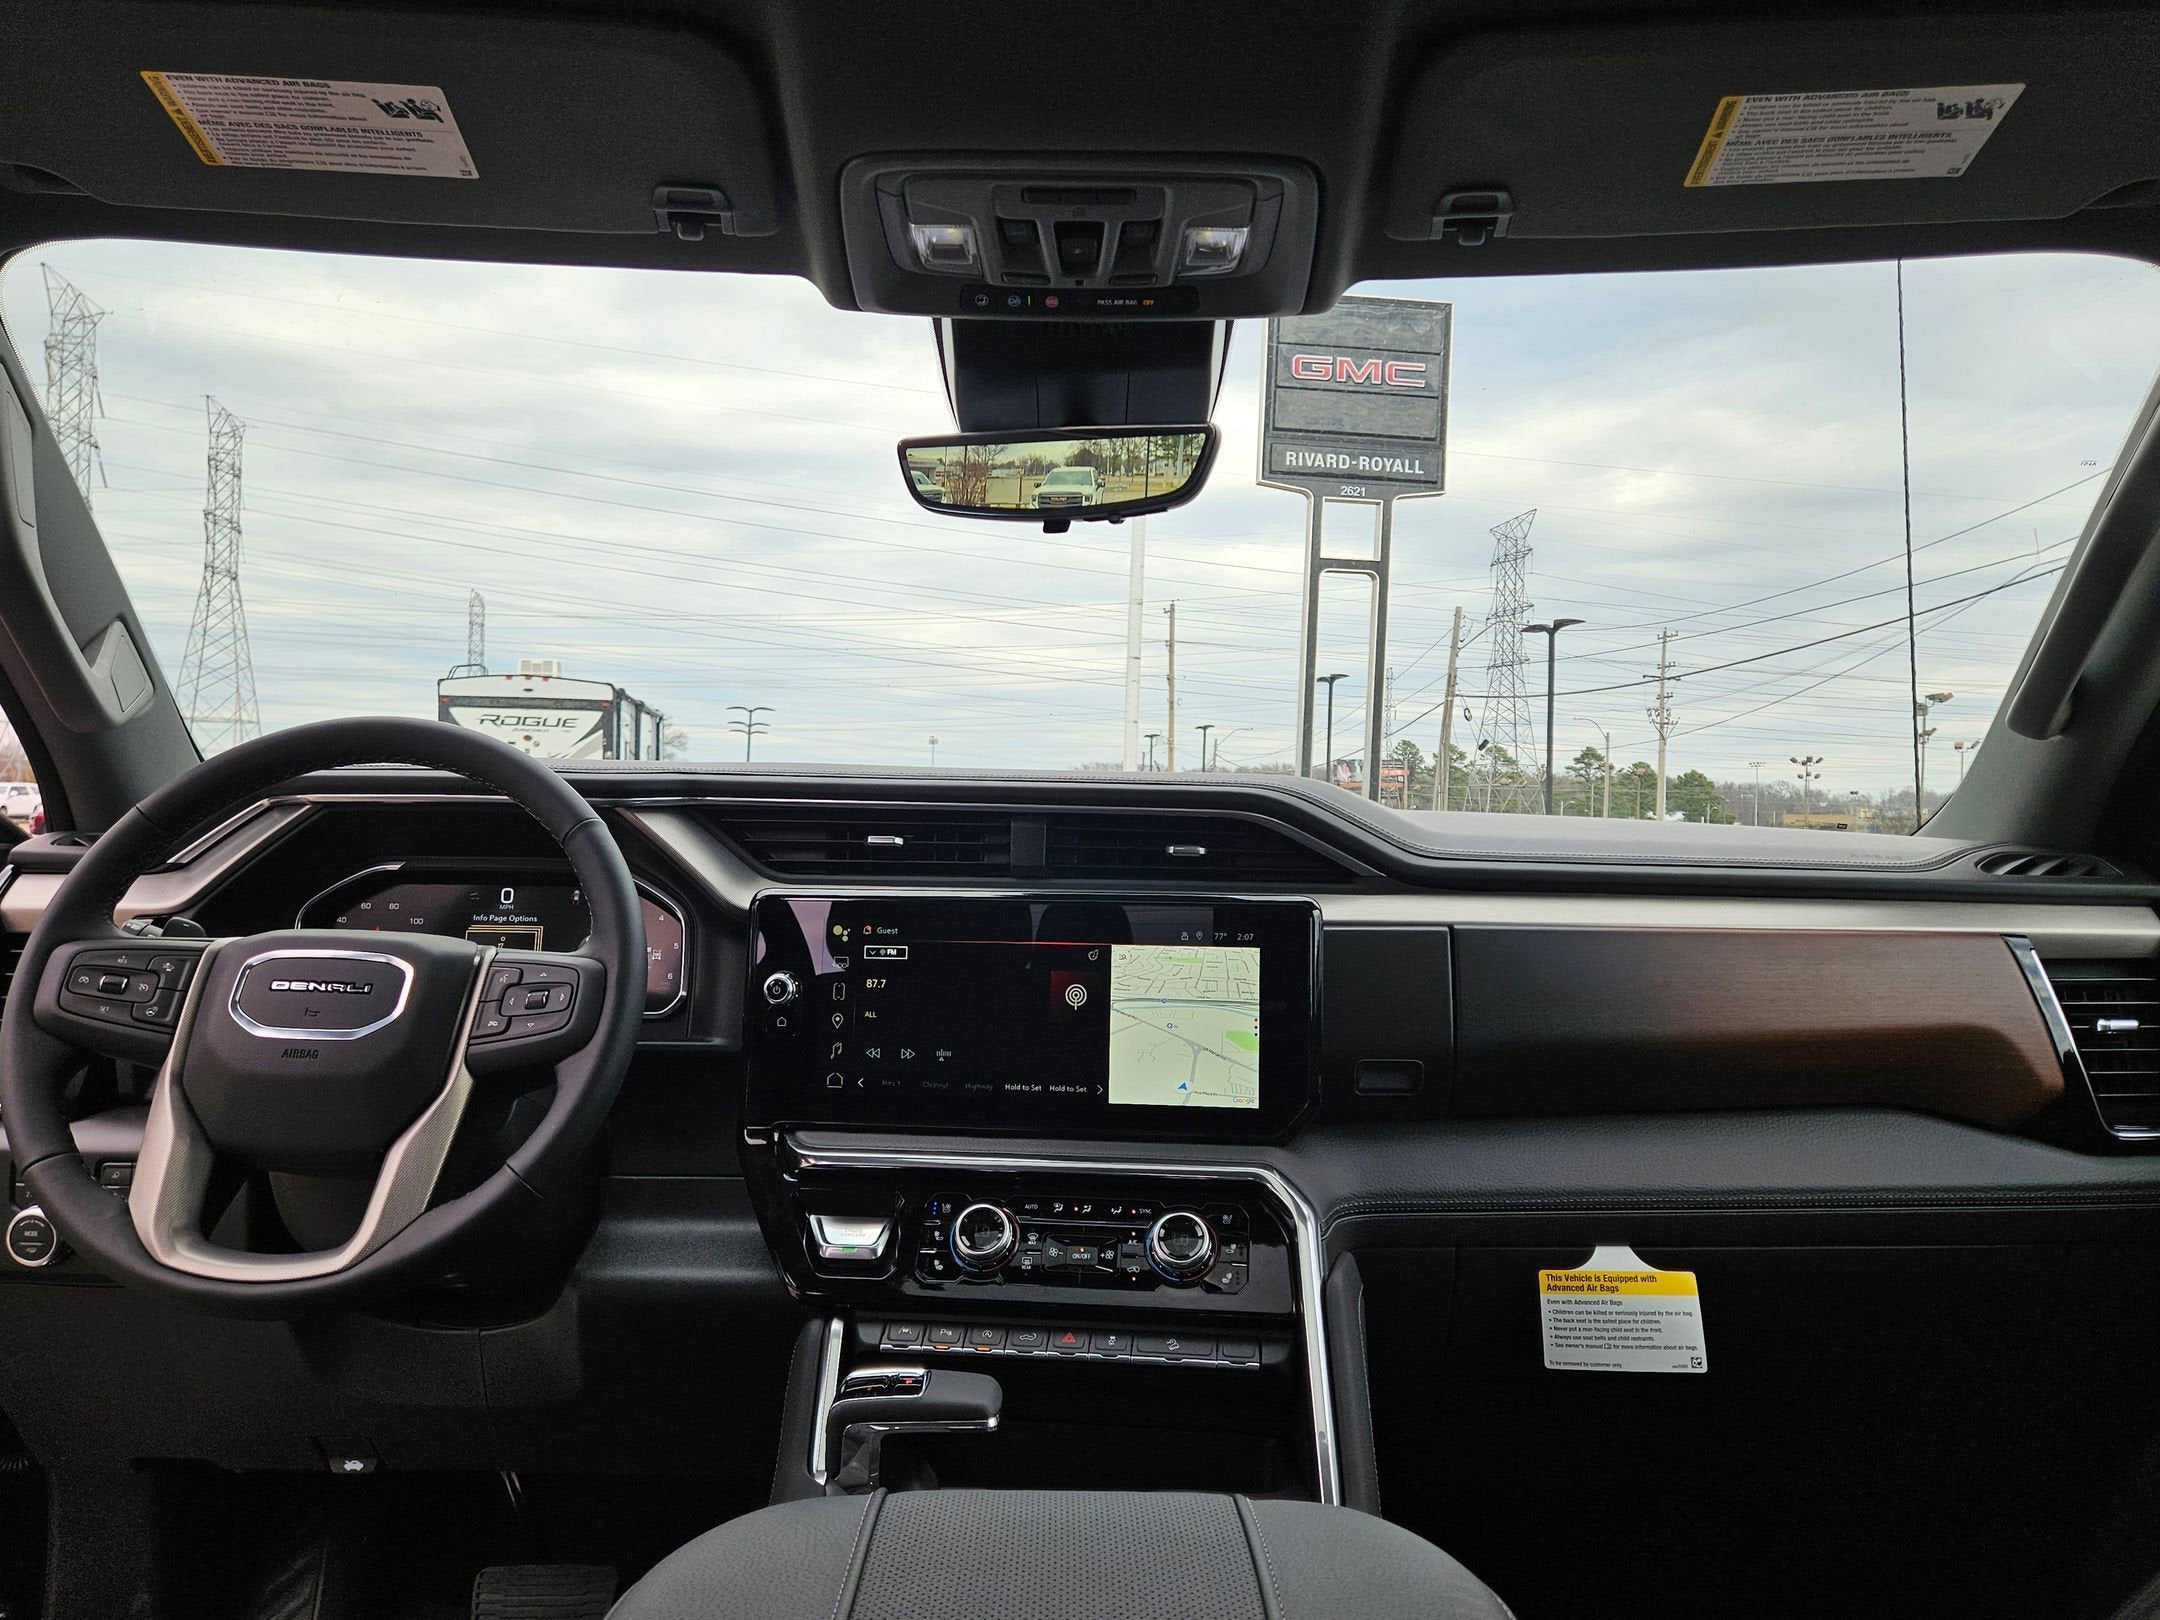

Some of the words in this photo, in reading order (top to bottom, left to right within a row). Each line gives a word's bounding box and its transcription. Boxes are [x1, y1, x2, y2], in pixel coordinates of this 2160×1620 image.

[225, 77, 280, 86] ADVANCED
[303, 81, 331, 89] BAGS
[1802, 93, 1859, 101] ADVANCED
[1291, 354, 1426, 388] GMC
[1285, 451, 1425, 474] RIVARD-ROYALL
[1340, 486, 1366, 496] 2621
[478, 714, 579, 729] ROGUE
[501, 887, 514, 904] 0
[360, 902, 372, 910] 60
[410, 917, 424, 925] 100
[473, 914, 488, 922] Info
[489, 915, 507, 923] Page
[508, 915, 538, 923] Options
[876, 927, 898, 935] Guest
[1237, 933, 1254, 941] 2:07
[270, 980, 373, 995] DENALI
[866, 979, 887, 989] 87.7
[281, 1049, 319, 1060] AIRBAG
[1004, 1083, 1021, 1091] Hold
[1049, 1084, 1065, 1092] Hold
[1232, 1096, 1255, 1104] Google
[1546, 1274, 1562, 1282] This
[1564, 1274, 1592, 1282] Vehicle
[1594, 1274, 1601, 1282] is
[1603, 1274, 1638, 1284] Equipped
[1640, 1275, 1657, 1283] with
[1547, 1284, 1584, 1292] Advanced
[1587, 1284, 1597, 1292] Air
[1600, 1284, 1619, 1293] Bags
